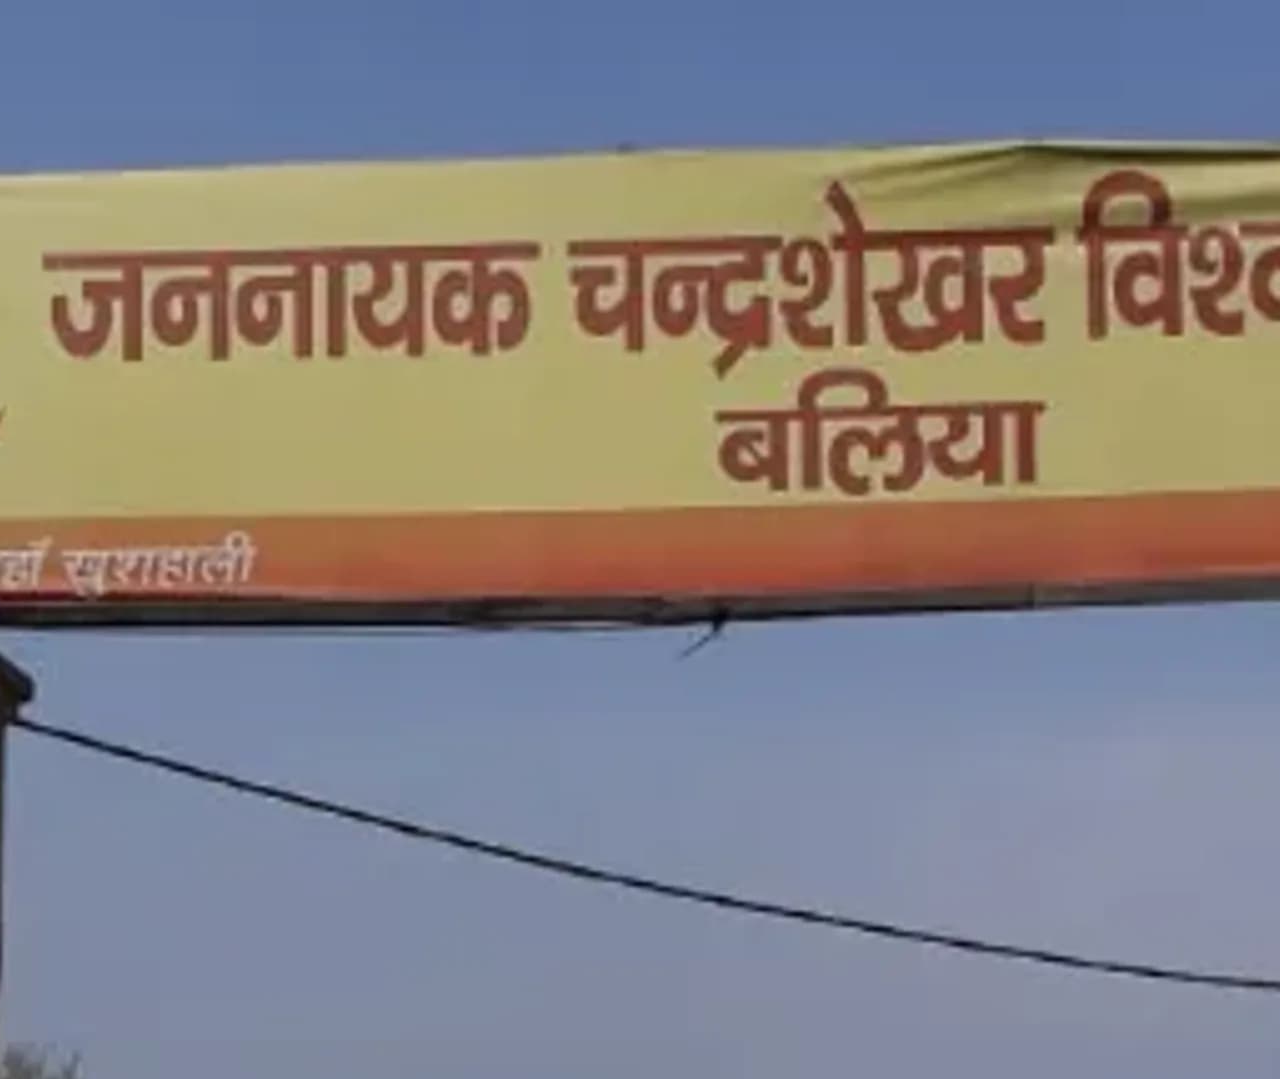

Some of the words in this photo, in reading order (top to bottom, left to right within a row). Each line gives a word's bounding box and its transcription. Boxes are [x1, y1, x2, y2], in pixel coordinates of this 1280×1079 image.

[42, 241, 541, 362] जननायक
[567, 180, 1055, 380] चन्द्रशेखर
[714, 368, 1048, 496] बलिया
